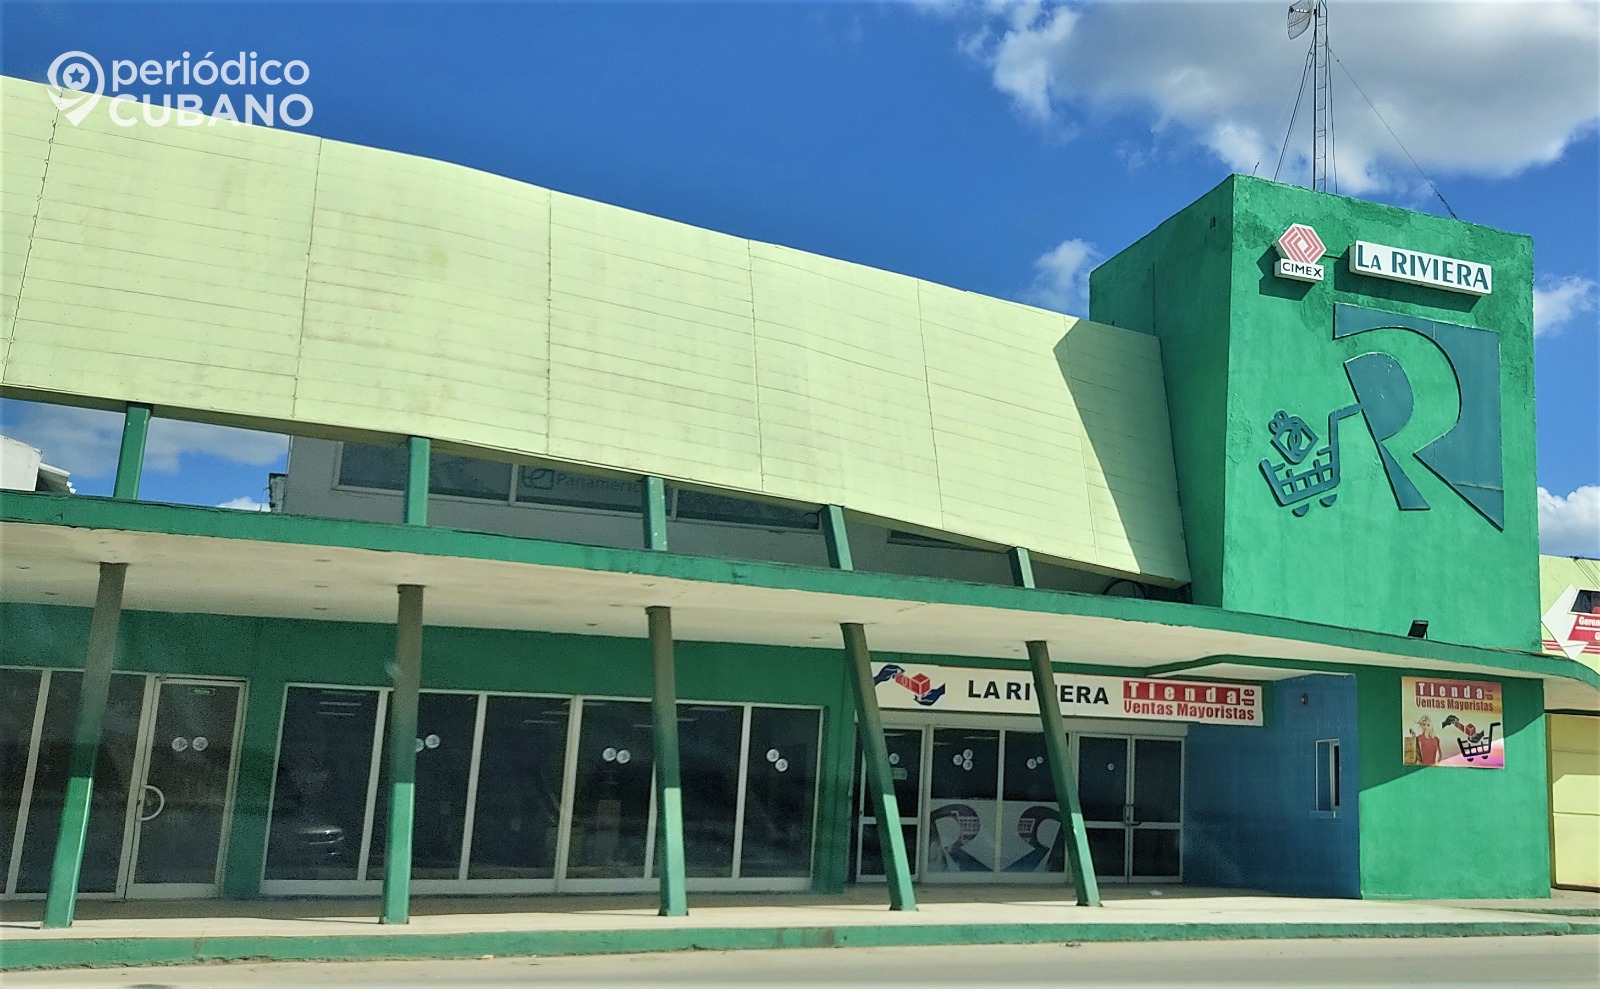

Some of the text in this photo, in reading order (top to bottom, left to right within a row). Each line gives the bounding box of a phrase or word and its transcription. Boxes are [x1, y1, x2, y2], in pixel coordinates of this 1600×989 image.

[1282, 262, 1323, 278] CIMEX
[1357, 244, 1489, 290] LA RIVIERA
[967, 680, 1110, 705] LA RIERA
[1128, 681, 1237, 704] Tienda
[1241, 689, 1255, 706] de
[1418, 683, 1483, 699] Tienda
[1124, 700, 1255, 721] Ventas Mayoristas
[1416, 697, 1494, 712] Ventas Mayoristas
